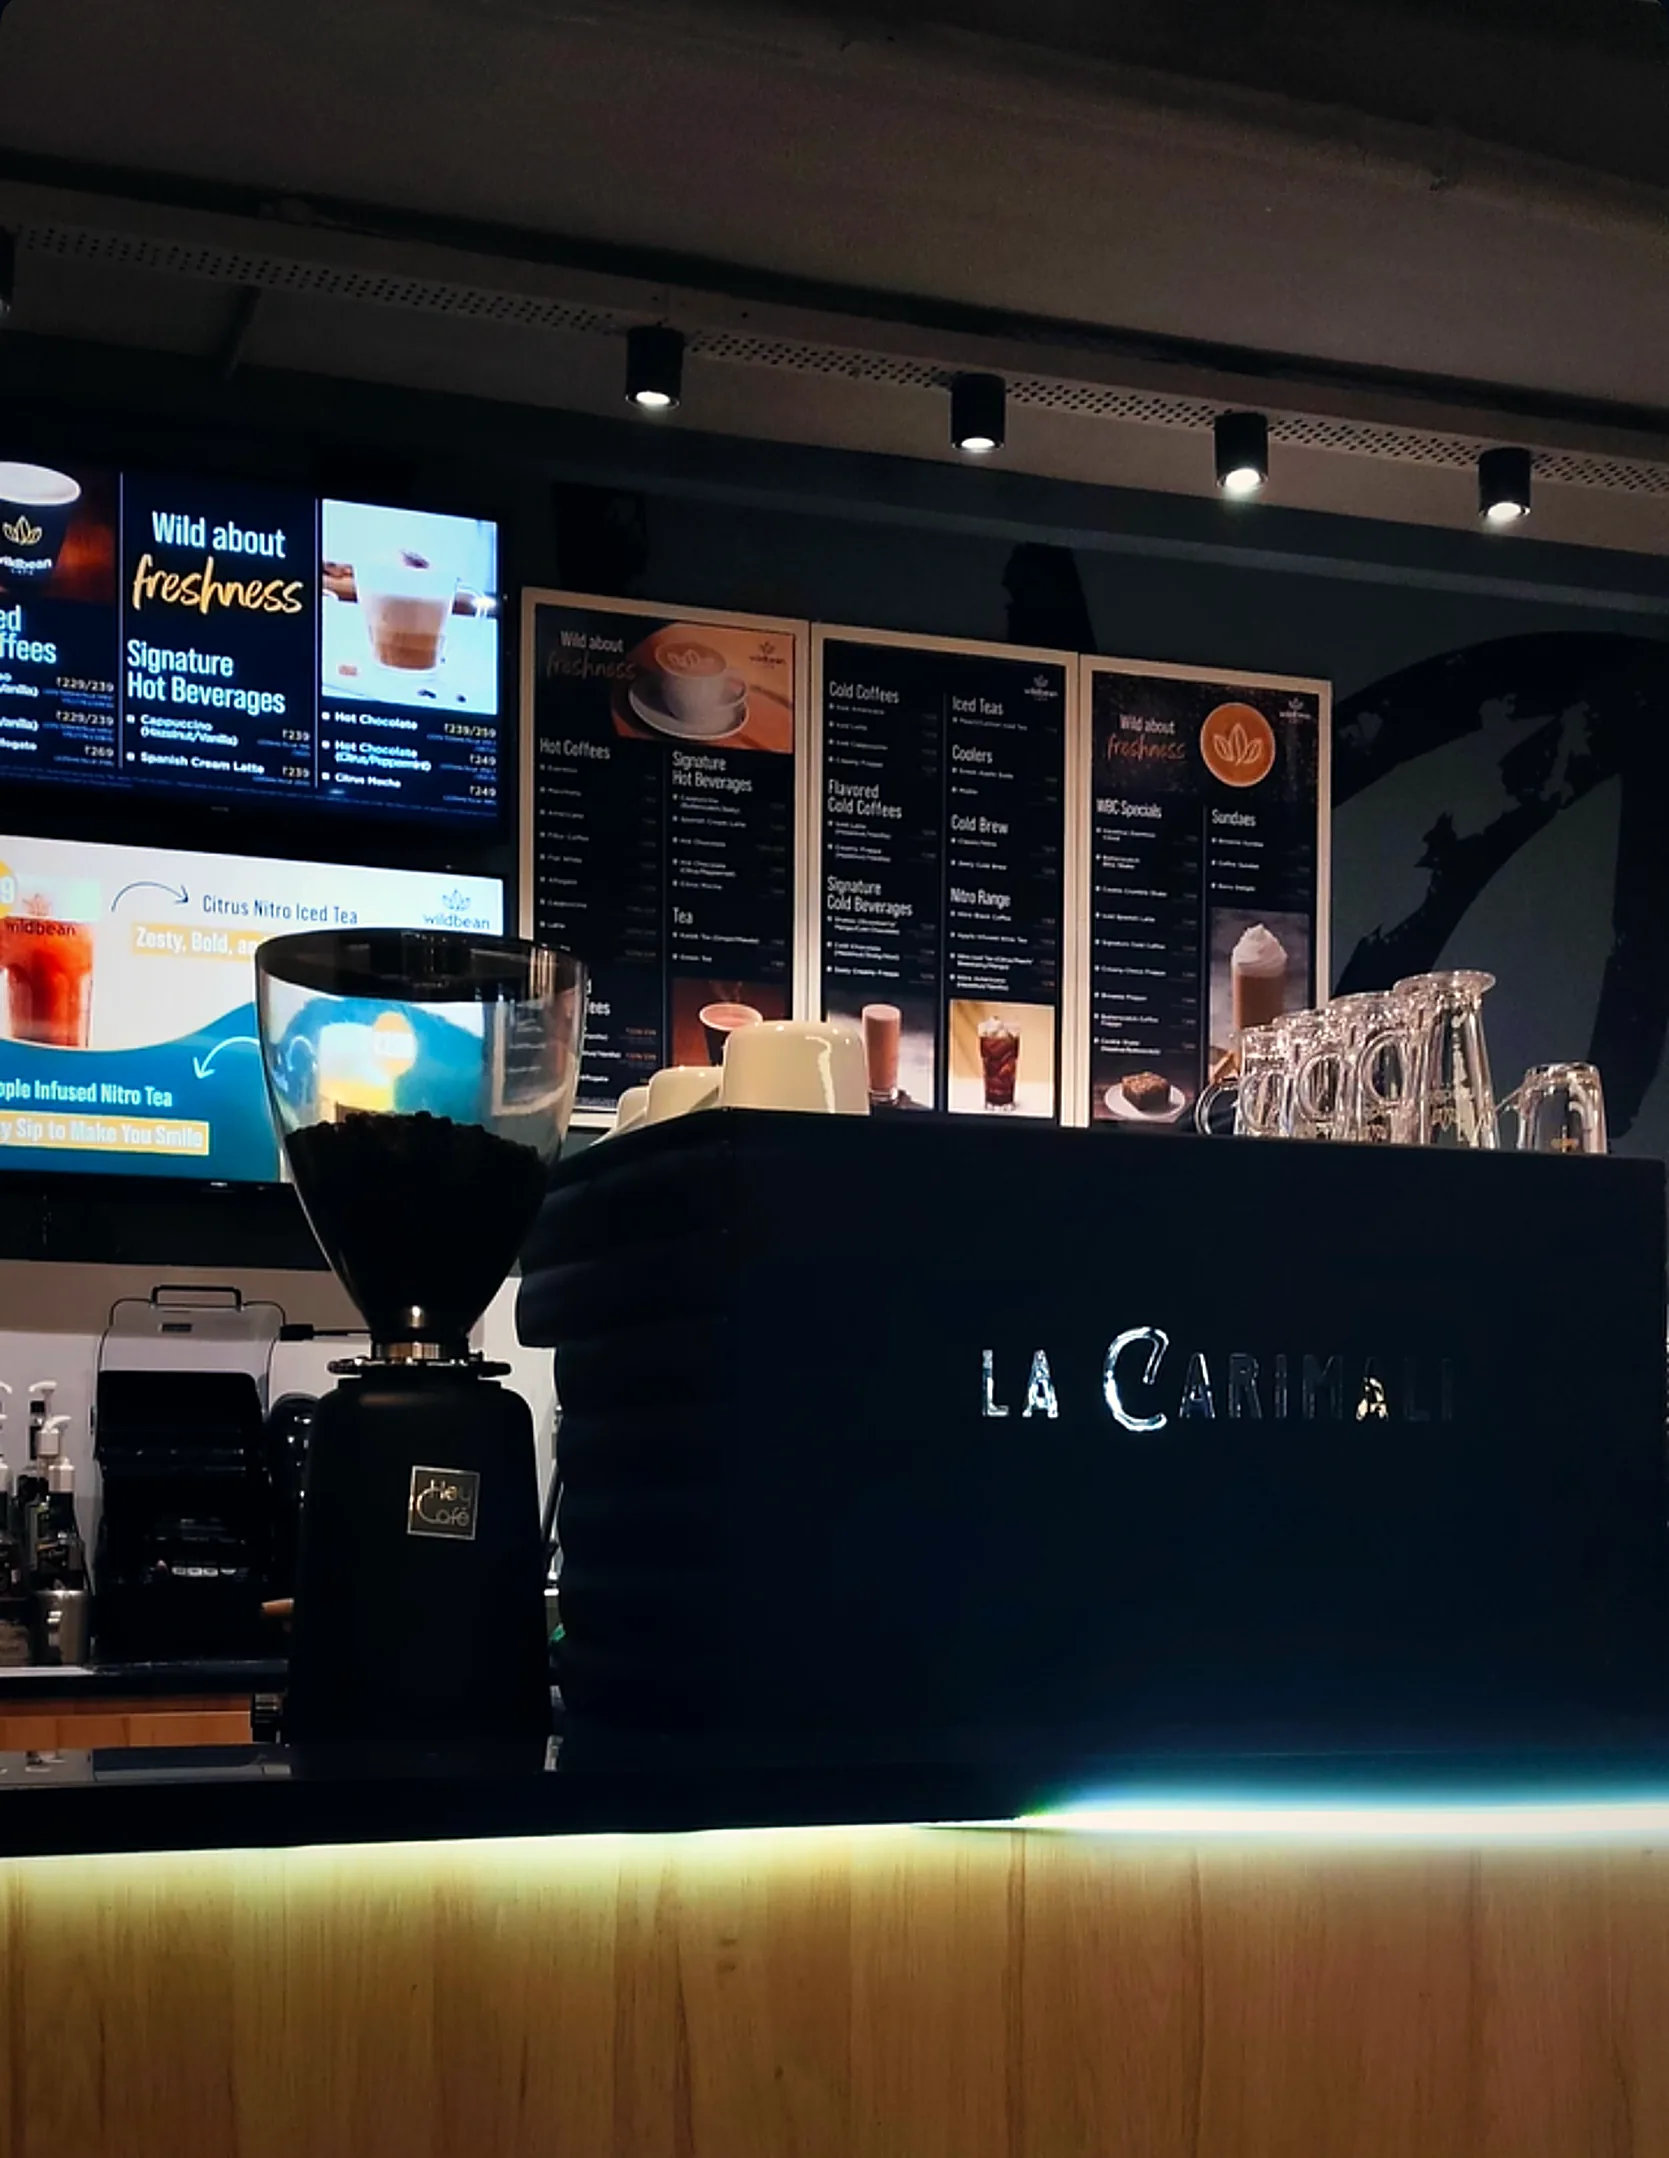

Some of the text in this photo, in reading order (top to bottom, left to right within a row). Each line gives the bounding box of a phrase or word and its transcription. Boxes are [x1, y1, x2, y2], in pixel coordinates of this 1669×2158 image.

[152, 510, 286, 559] Wild about
[132, 553, 303, 615] freshness
[560, 630, 623, 653] Wild about
[127, 639, 234, 677] Signature
[546, 650, 637, 680] freshness
[127, 670, 286, 717] Hot Beverages
[829, 680, 900, 704] Cold Coffees
[952, 695, 1004, 716] Iced Teas
[140, 714, 213, 731] Cappuccino
[334, 711, 418, 731] Hot Chocolate
[1119, 713, 1176, 735] Wild about
[334, 740, 418, 758] Hot Chocolate
[539, 736, 611, 760] Hot Coffees
[952, 743, 993, 764] Coolers
[1107, 732, 1186, 761] freshness
[140, 751, 265, 774] Spanish Cream Latte
[672, 750, 727, 771] Signature
[672, 770, 753, 794] Hot Beverages
[828, 778, 880, 800] Flavored
[827, 795, 903, 820] Cold Coffees
[1096, 798, 1162, 819] WBC Specials
[1211, 808, 1257, 827] Sundaes
[951, 813, 1010, 835] Cold Brew
[827, 874, 882, 896] Signature
[203, 894, 358, 925] Citrus Nitro Iced Tea
[827, 893, 914, 919] Cold Beverages
[950, 887, 1012, 910] Nitro Range
[423, 912, 491, 931] wildbean
[672, 906, 695, 924] Tea
[136, 926, 187, 955] Zesty,
[192, 931, 233, 955] Bold,
[34, 1079, 97, 1103] Infused
[101, 1082, 141, 1105] Nitro
[145, 1086, 173, 1107] Tea
[16, 1117, 43, 1142] Sip
[48, 1120, 65, 1140] to
[70, 1120, 117, 1143] Make
[121, 1124, 151, 1145] You
[155, 1127, 204, 1148] Smile
[982, 1349, 1059, 1419] LA
